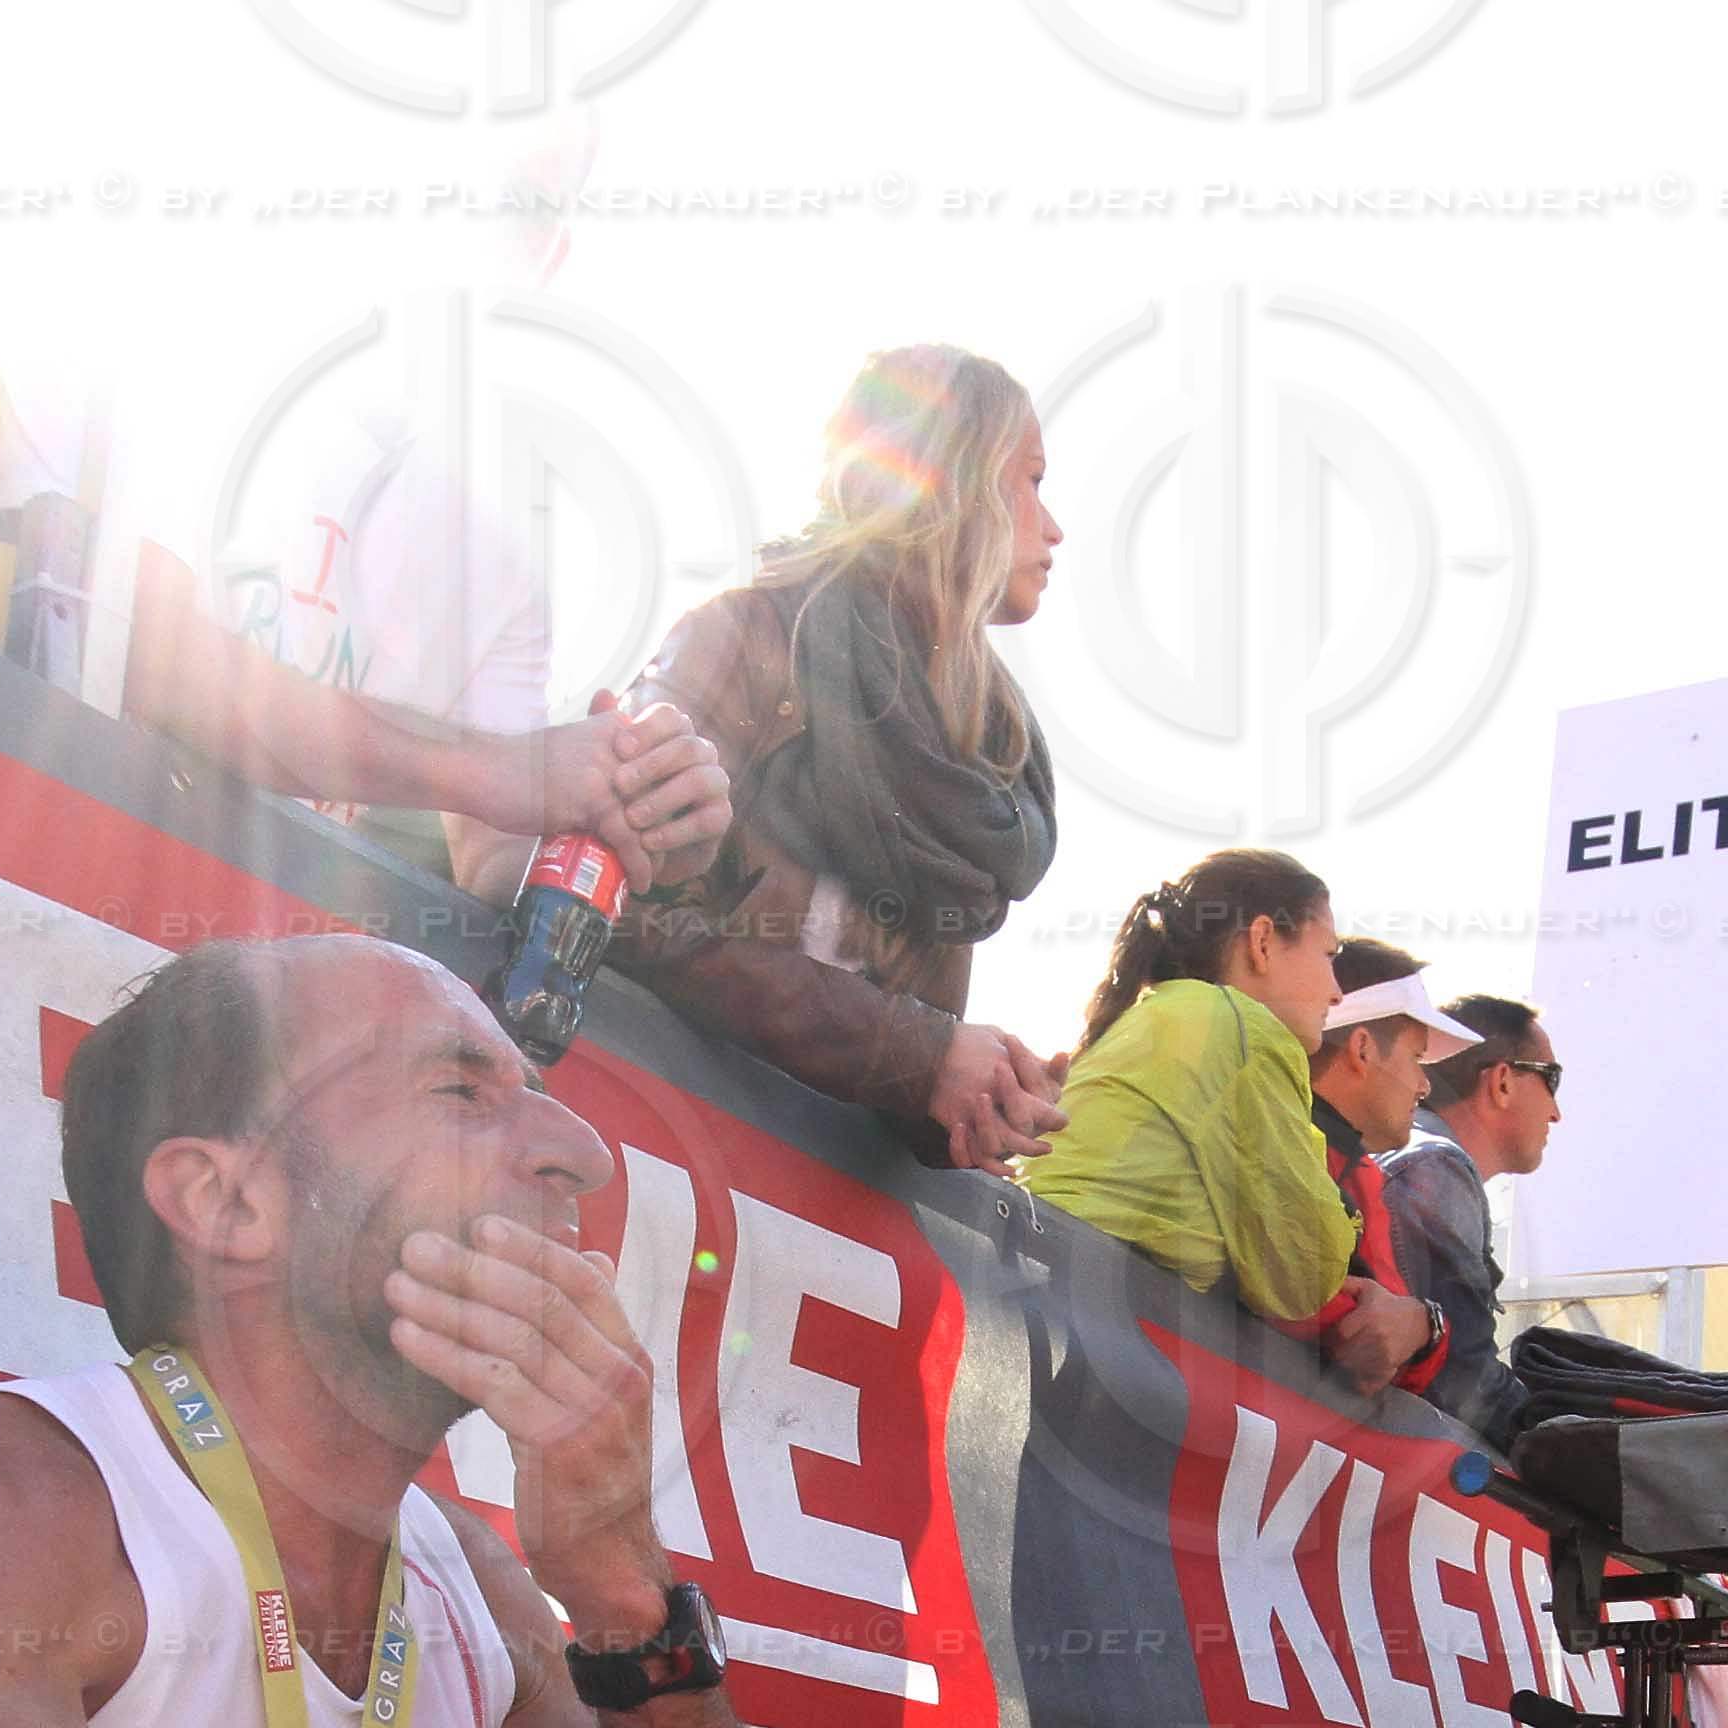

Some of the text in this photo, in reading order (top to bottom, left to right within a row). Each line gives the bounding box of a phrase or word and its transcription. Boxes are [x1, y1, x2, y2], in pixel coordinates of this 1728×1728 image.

[152, 1351, 225, 1448] GRAZ
[256, 1593, 278, 1671] ZEITUNG
[271, 1591, 294, 1667] KLEINE
[373, 1606, 409, 1722] GRAZ
